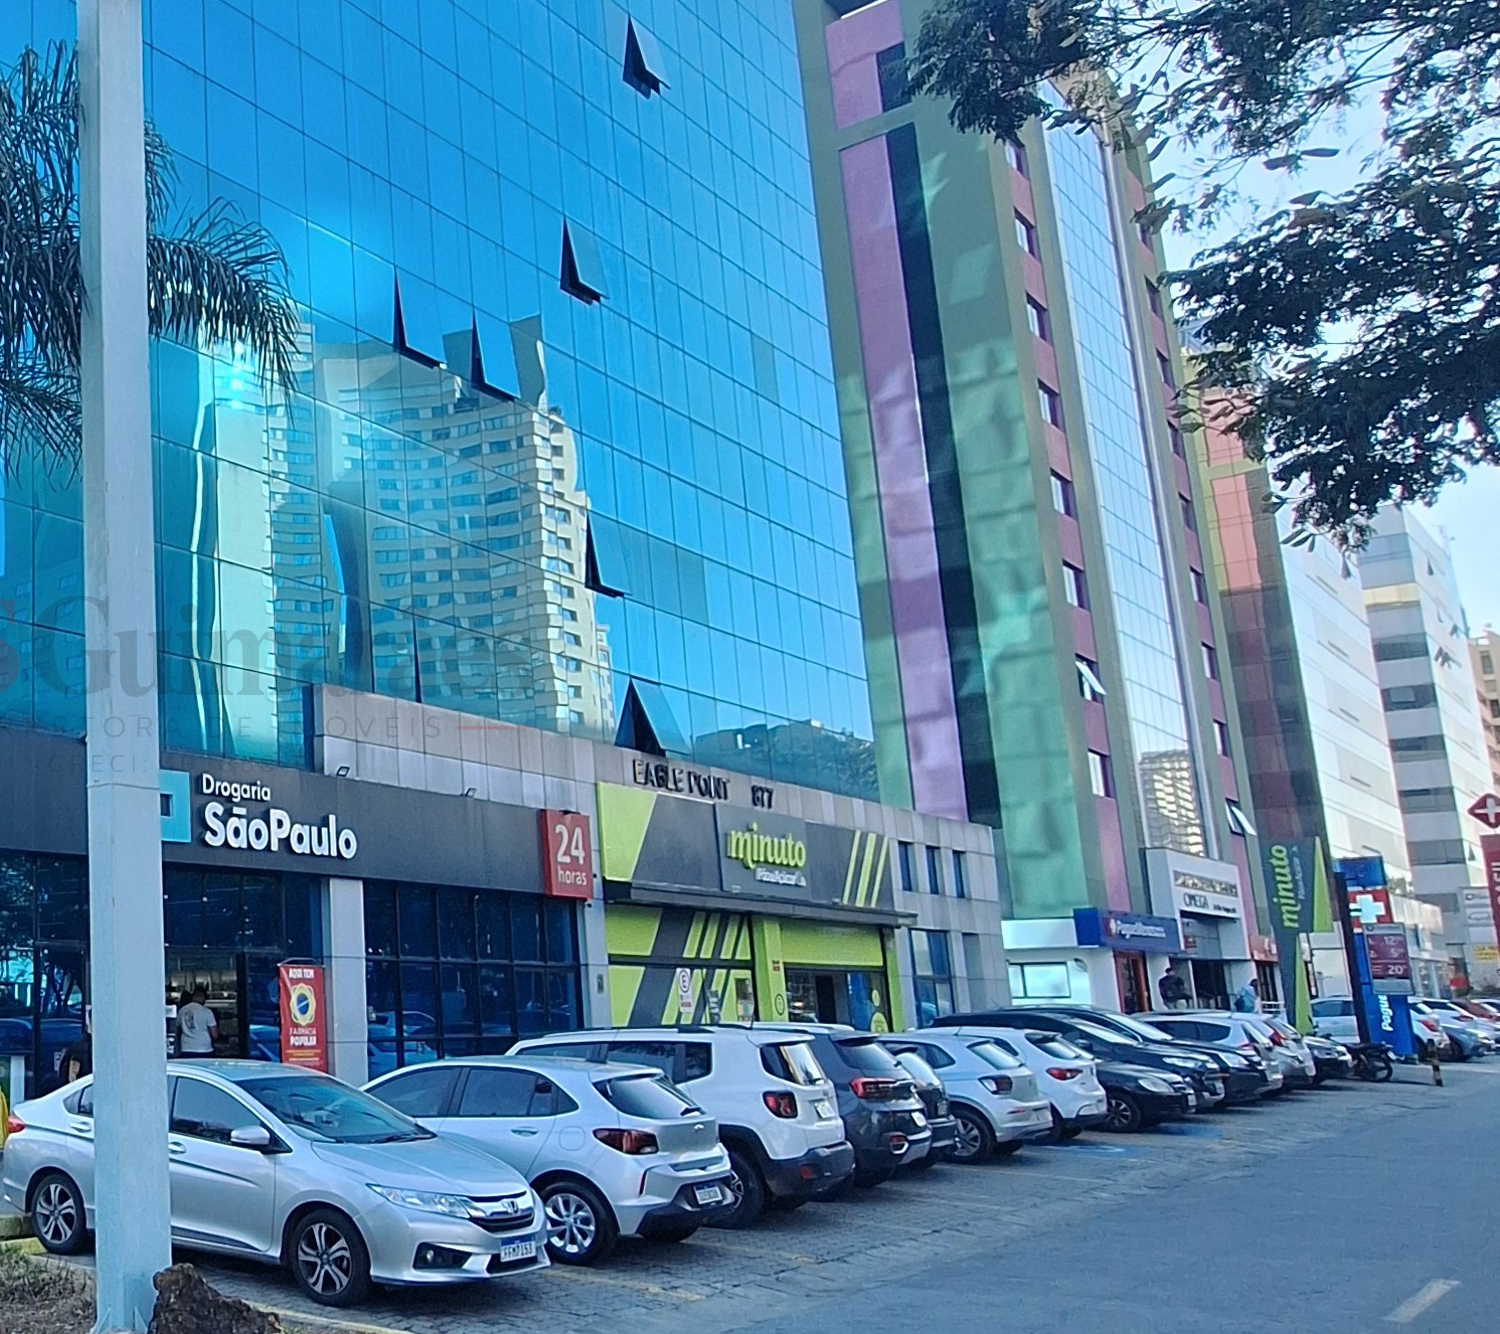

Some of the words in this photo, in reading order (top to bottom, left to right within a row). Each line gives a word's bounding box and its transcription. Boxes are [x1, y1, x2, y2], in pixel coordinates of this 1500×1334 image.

[201, 773, 271, 803] Drogaria
[632, 759, 684, 793] EAGLE
[687, 770, 731, 801] POINT
[203, 801, 358, 860] SãoPaulo
[555, 824, 586, 865] 24
[728, 823, 805, 867] minuto
[557, 864, 588, 887] horas
[1268, 845, 1302, 929] minuto
[1381, 993, 1395, 1032] Pague
